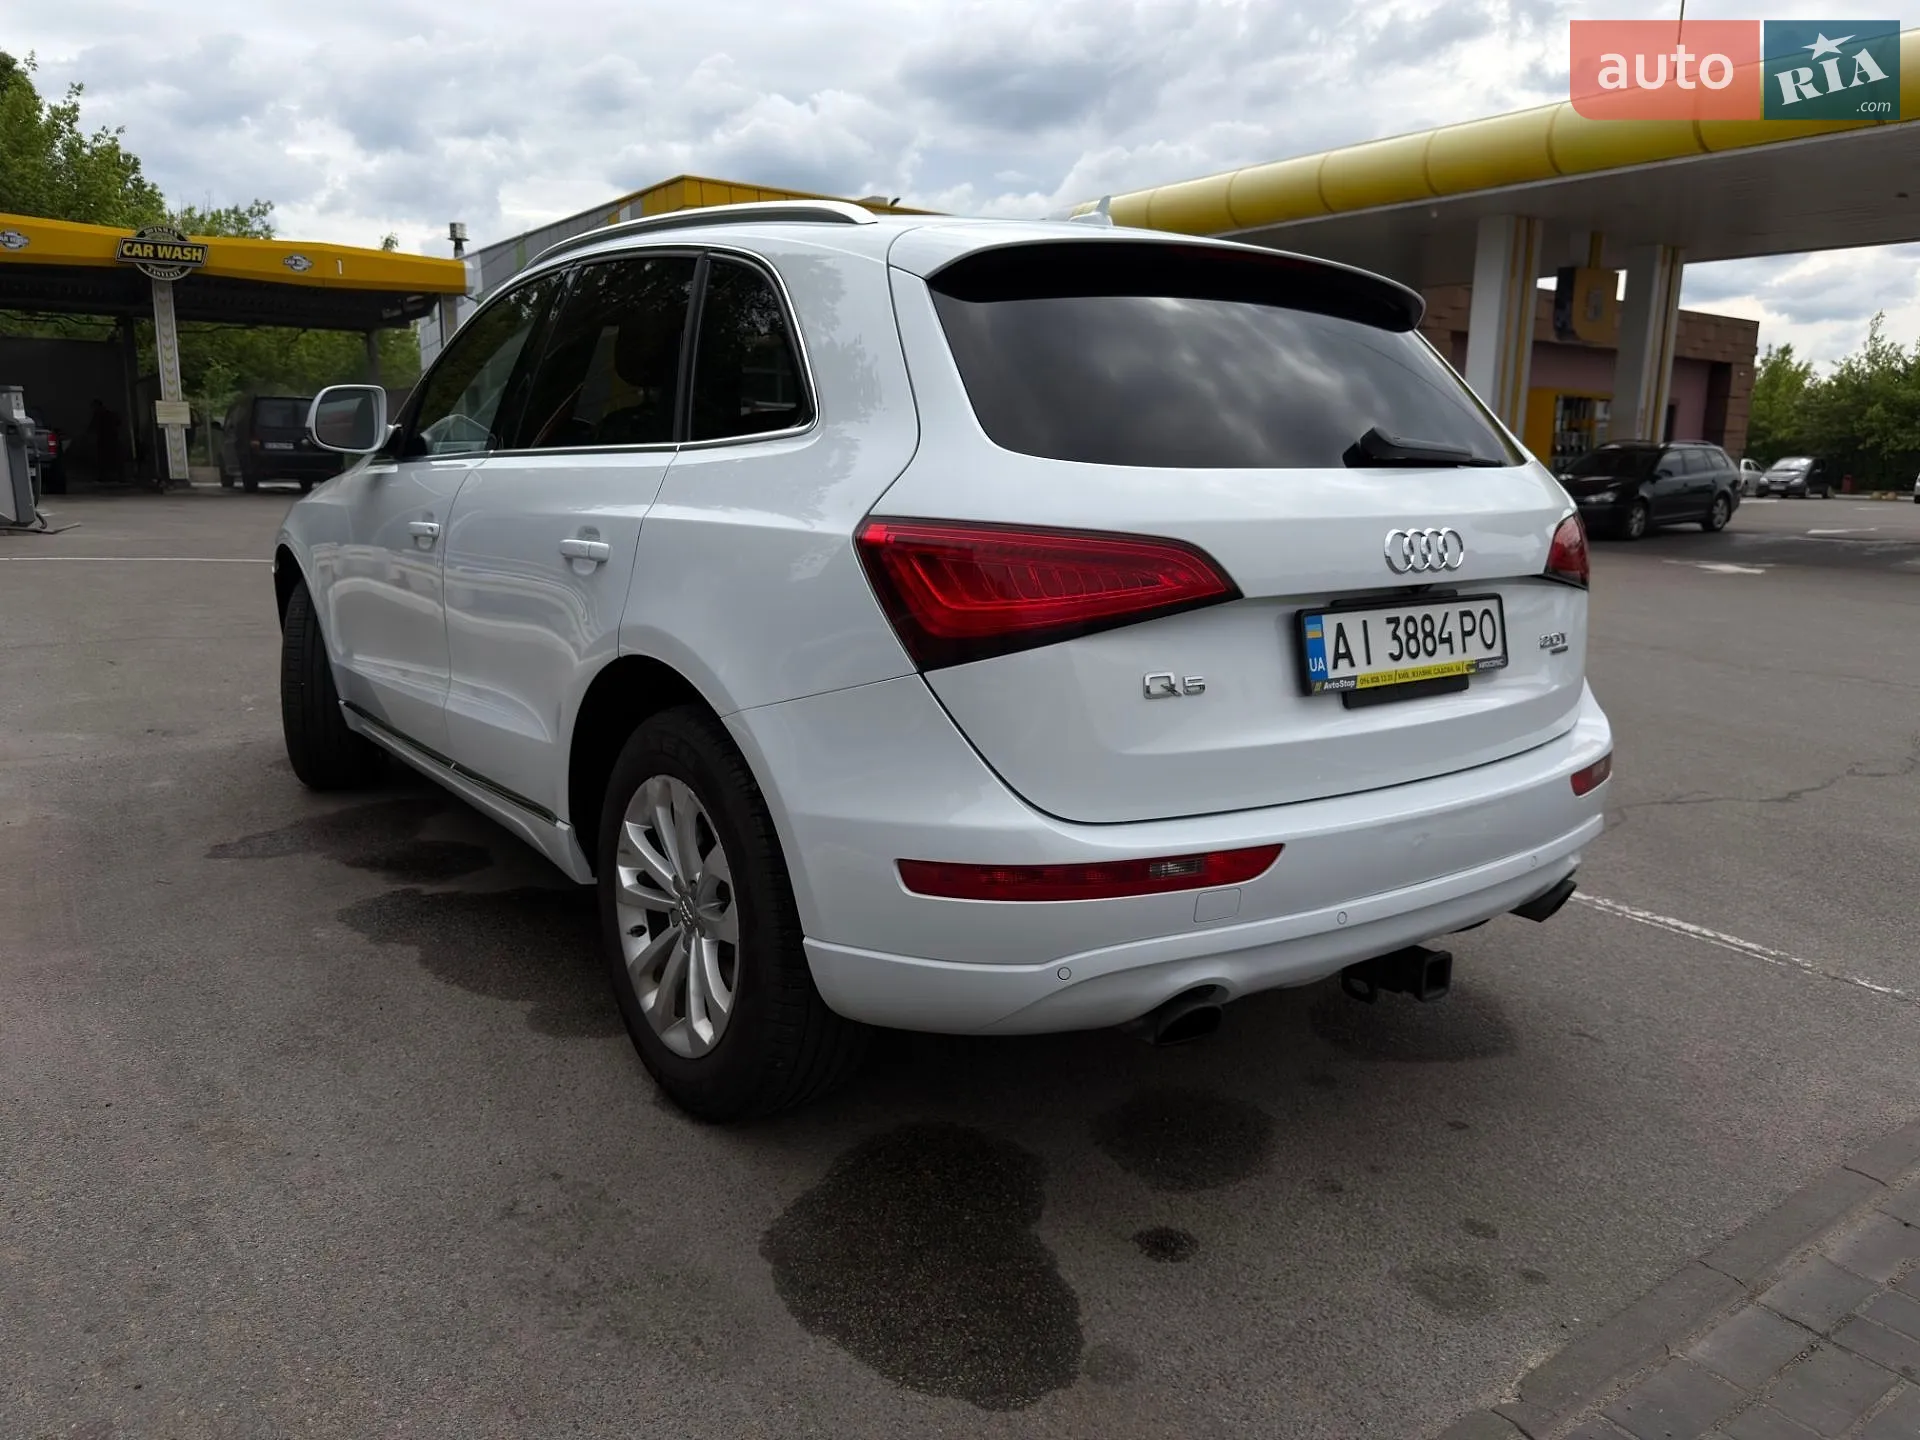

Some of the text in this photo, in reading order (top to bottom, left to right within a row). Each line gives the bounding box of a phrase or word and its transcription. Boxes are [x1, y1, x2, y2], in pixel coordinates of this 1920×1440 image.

[122, 242, 203, 262] CAR WASH
[336, 259, 343, 275] 1
[1332, 620, 1371, 670] AI
[1386, 612, 1454, 662] 3884
[1308, 657, 1326, 673] UA
[1143, 671, 1206, 700] Q5
[1323, 678, 1356, 691] AvtoStop
